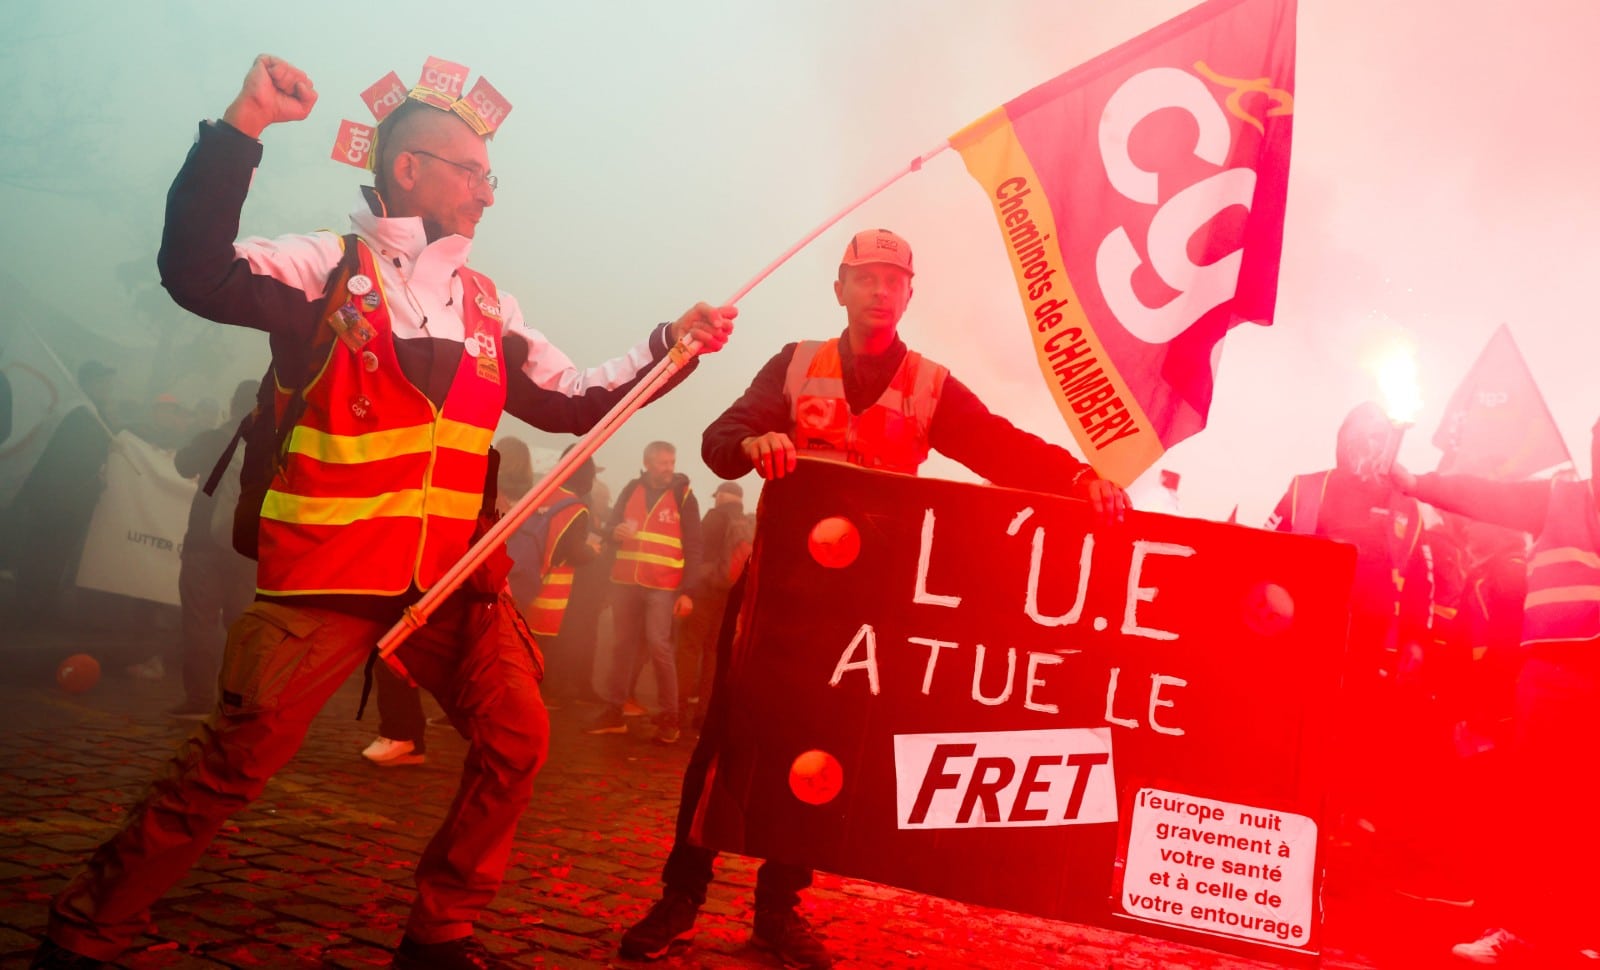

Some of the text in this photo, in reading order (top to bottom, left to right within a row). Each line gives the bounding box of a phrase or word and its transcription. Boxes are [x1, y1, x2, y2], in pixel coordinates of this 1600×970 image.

[425, 67, 461, 93] cgt
[472, 88, 502, 124] cgt
[347, 126, 370, 163] cgt
[996, 176, 1140, 452] Cheminots de CHAMBERY
[351, 403, 367, 418] cgt
[128, 529, 173, 552] LUTTER
[828, 624, 881, 696] A
[1104, 667, 1188, 736] LE
[1156, 822, 1290, 858] gravement à
[1239, 813, 1282, 831] nuit
[1160, 847, 1282, 882] votre santé
[1149, 872, 1282, 908] et à celle de
[1128, 893, 1303, 940] votre entourage
